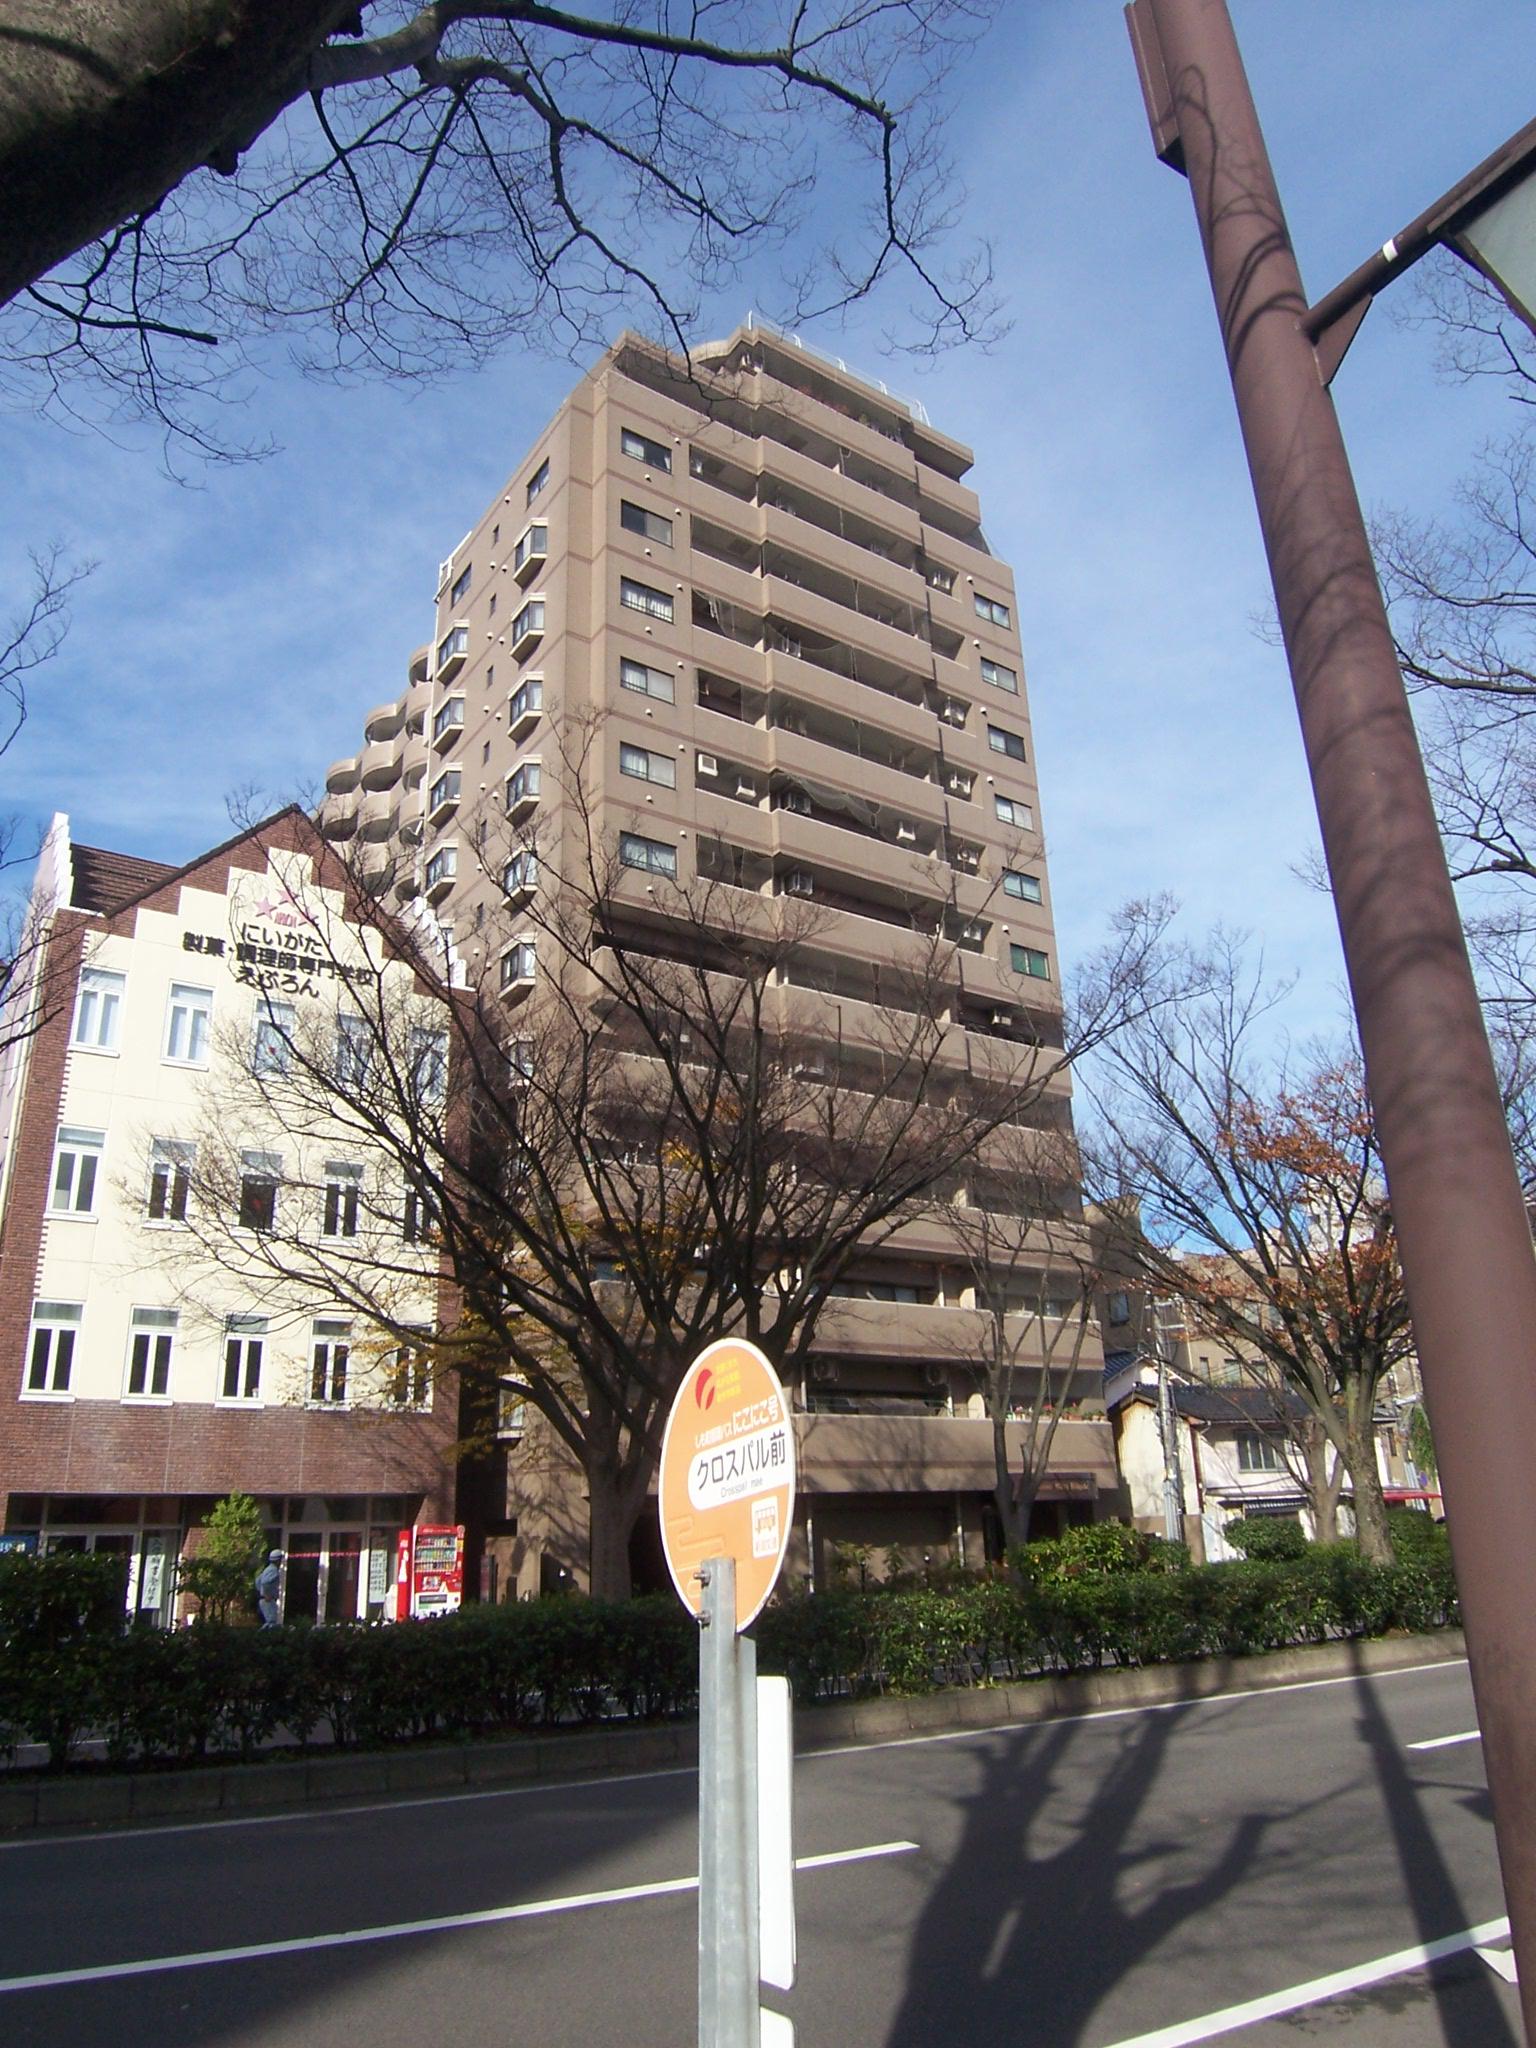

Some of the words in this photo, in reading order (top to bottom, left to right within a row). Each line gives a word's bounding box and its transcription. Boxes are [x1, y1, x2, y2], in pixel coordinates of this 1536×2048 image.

[183, 931, 374, 986] 製菓・調理師専門学校
[242, 923, 321, 956] にいがた
[697, 1429, 785, 1490] クロスパル前
